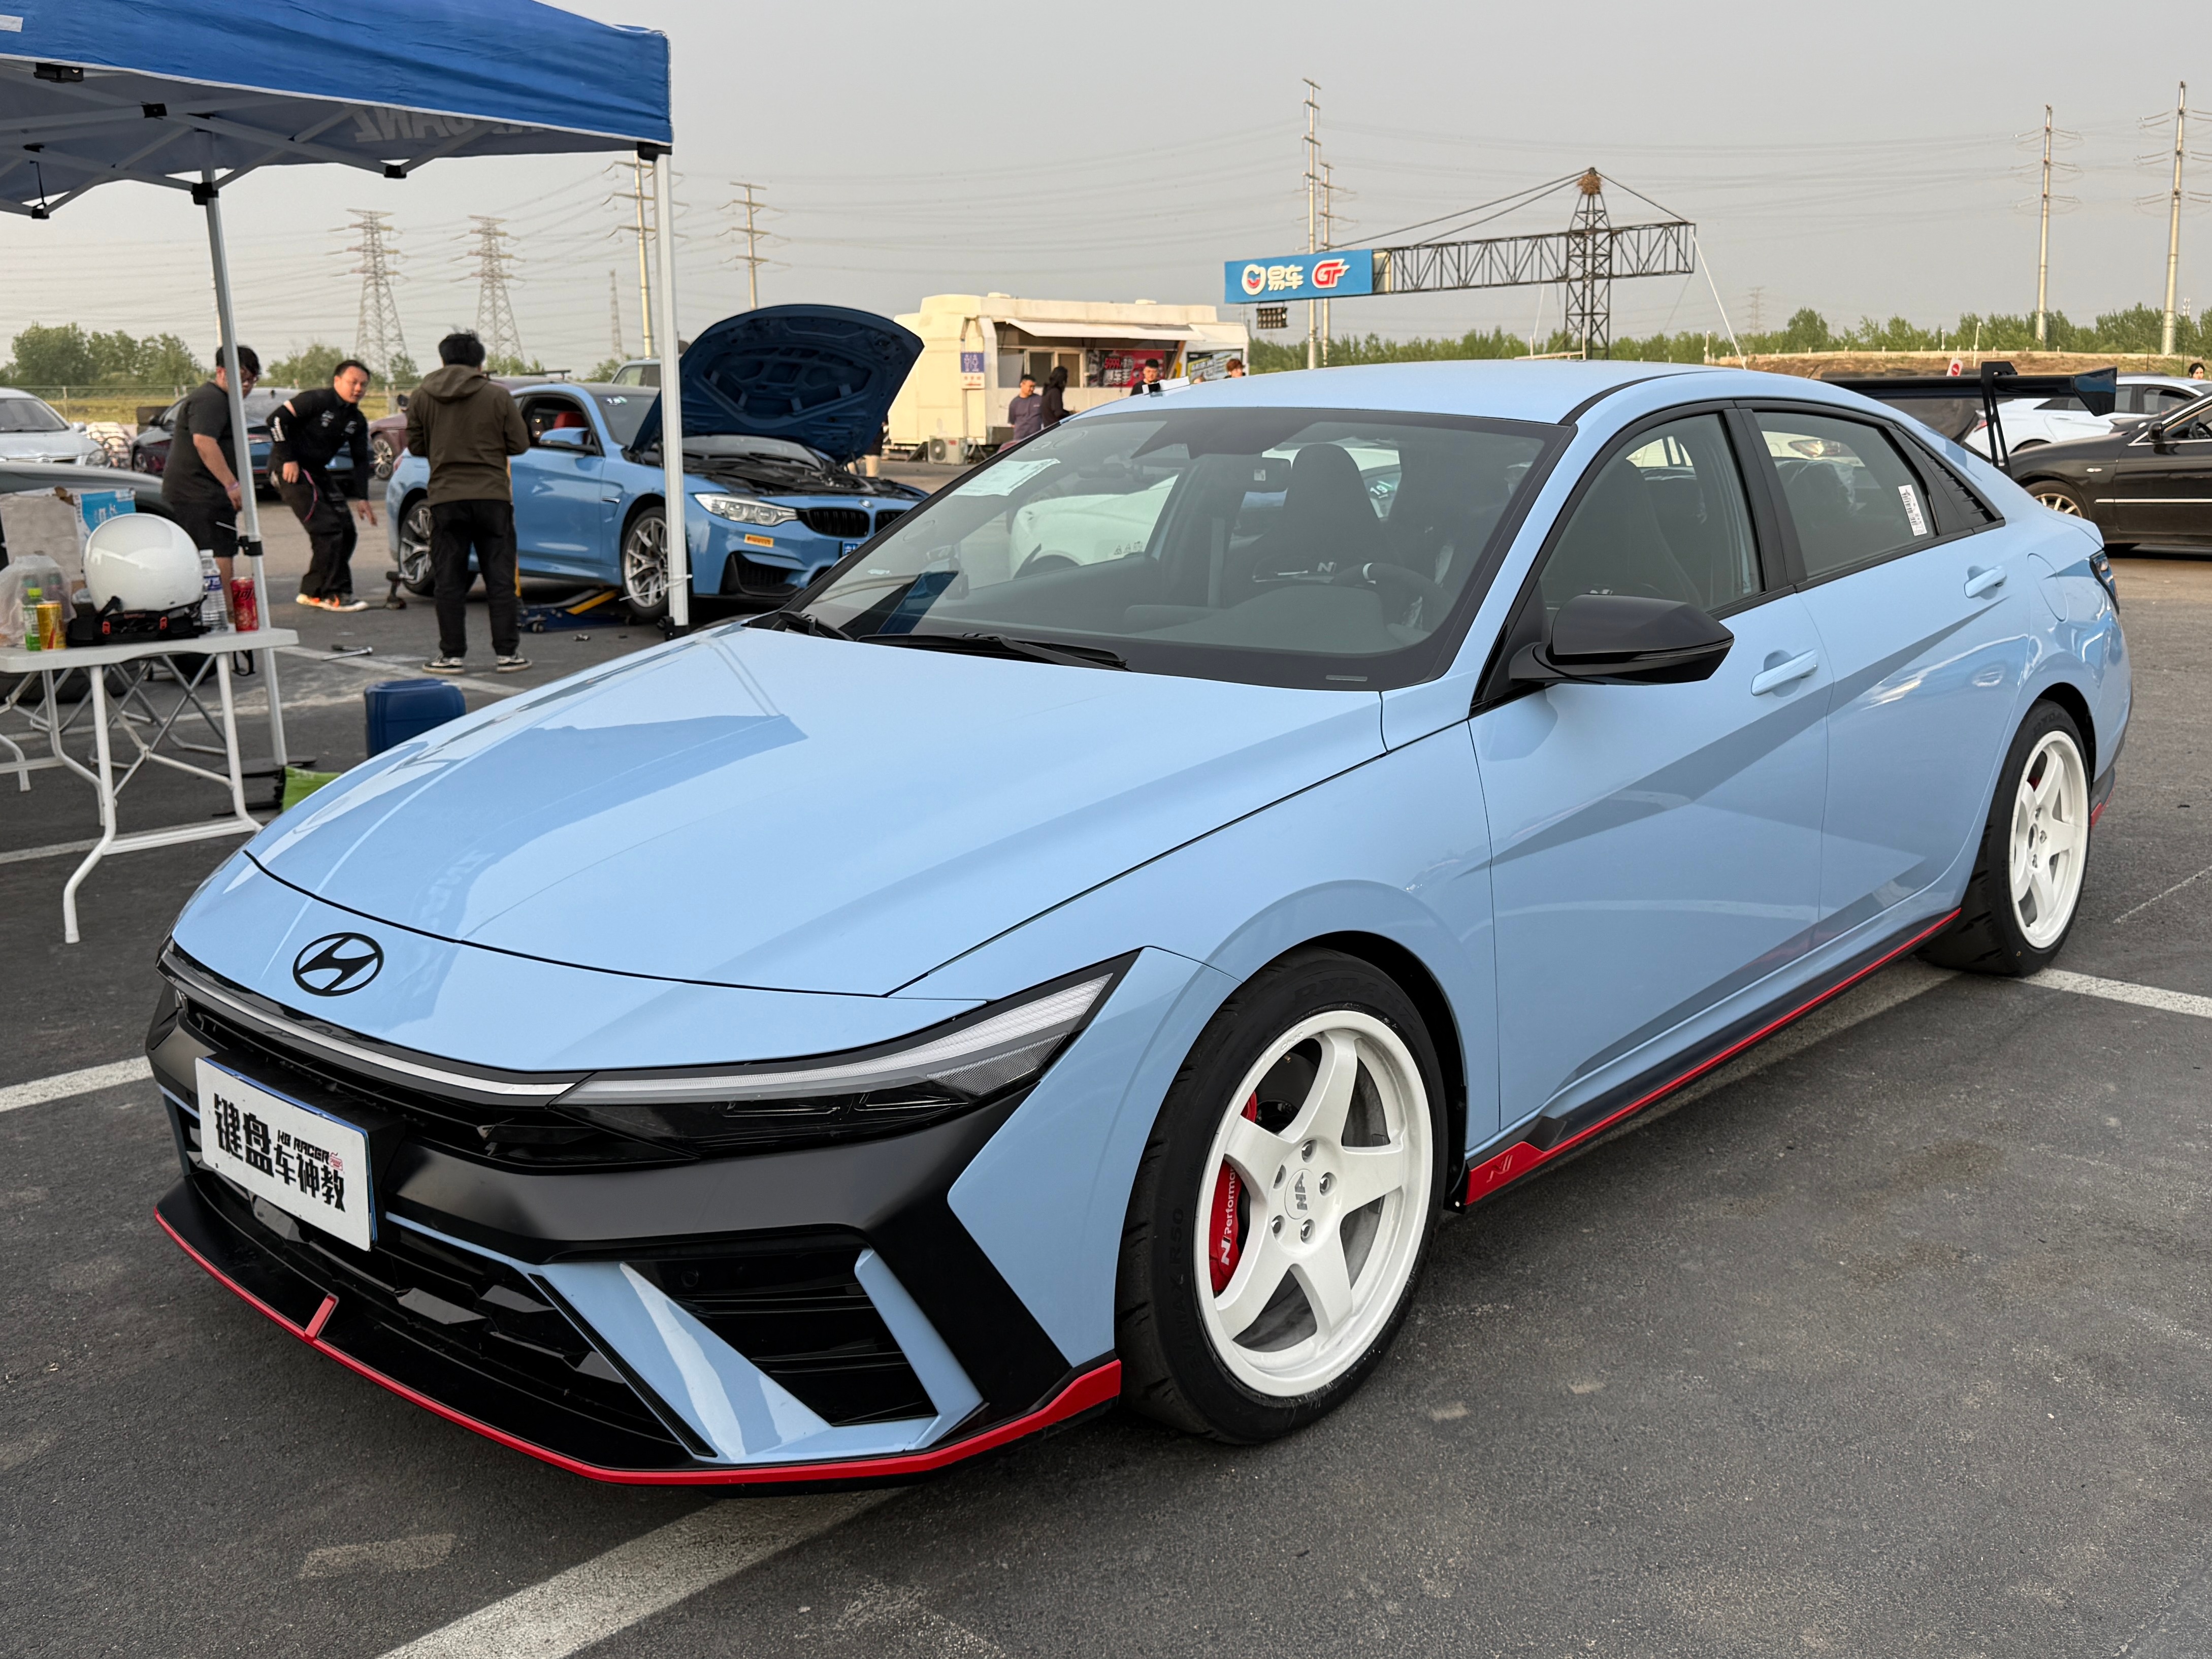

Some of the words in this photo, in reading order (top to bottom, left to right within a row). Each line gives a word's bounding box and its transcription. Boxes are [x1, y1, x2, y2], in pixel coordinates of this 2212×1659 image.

[1267, 264, 1304, 291] 易车
[1312, 258, 1350, 288] GT
[214, 1093, 346, 1213] 键盘车神教
[294, 1137, 329, 1165] RACER
[1169, 1208, 1184, 1269] R50
